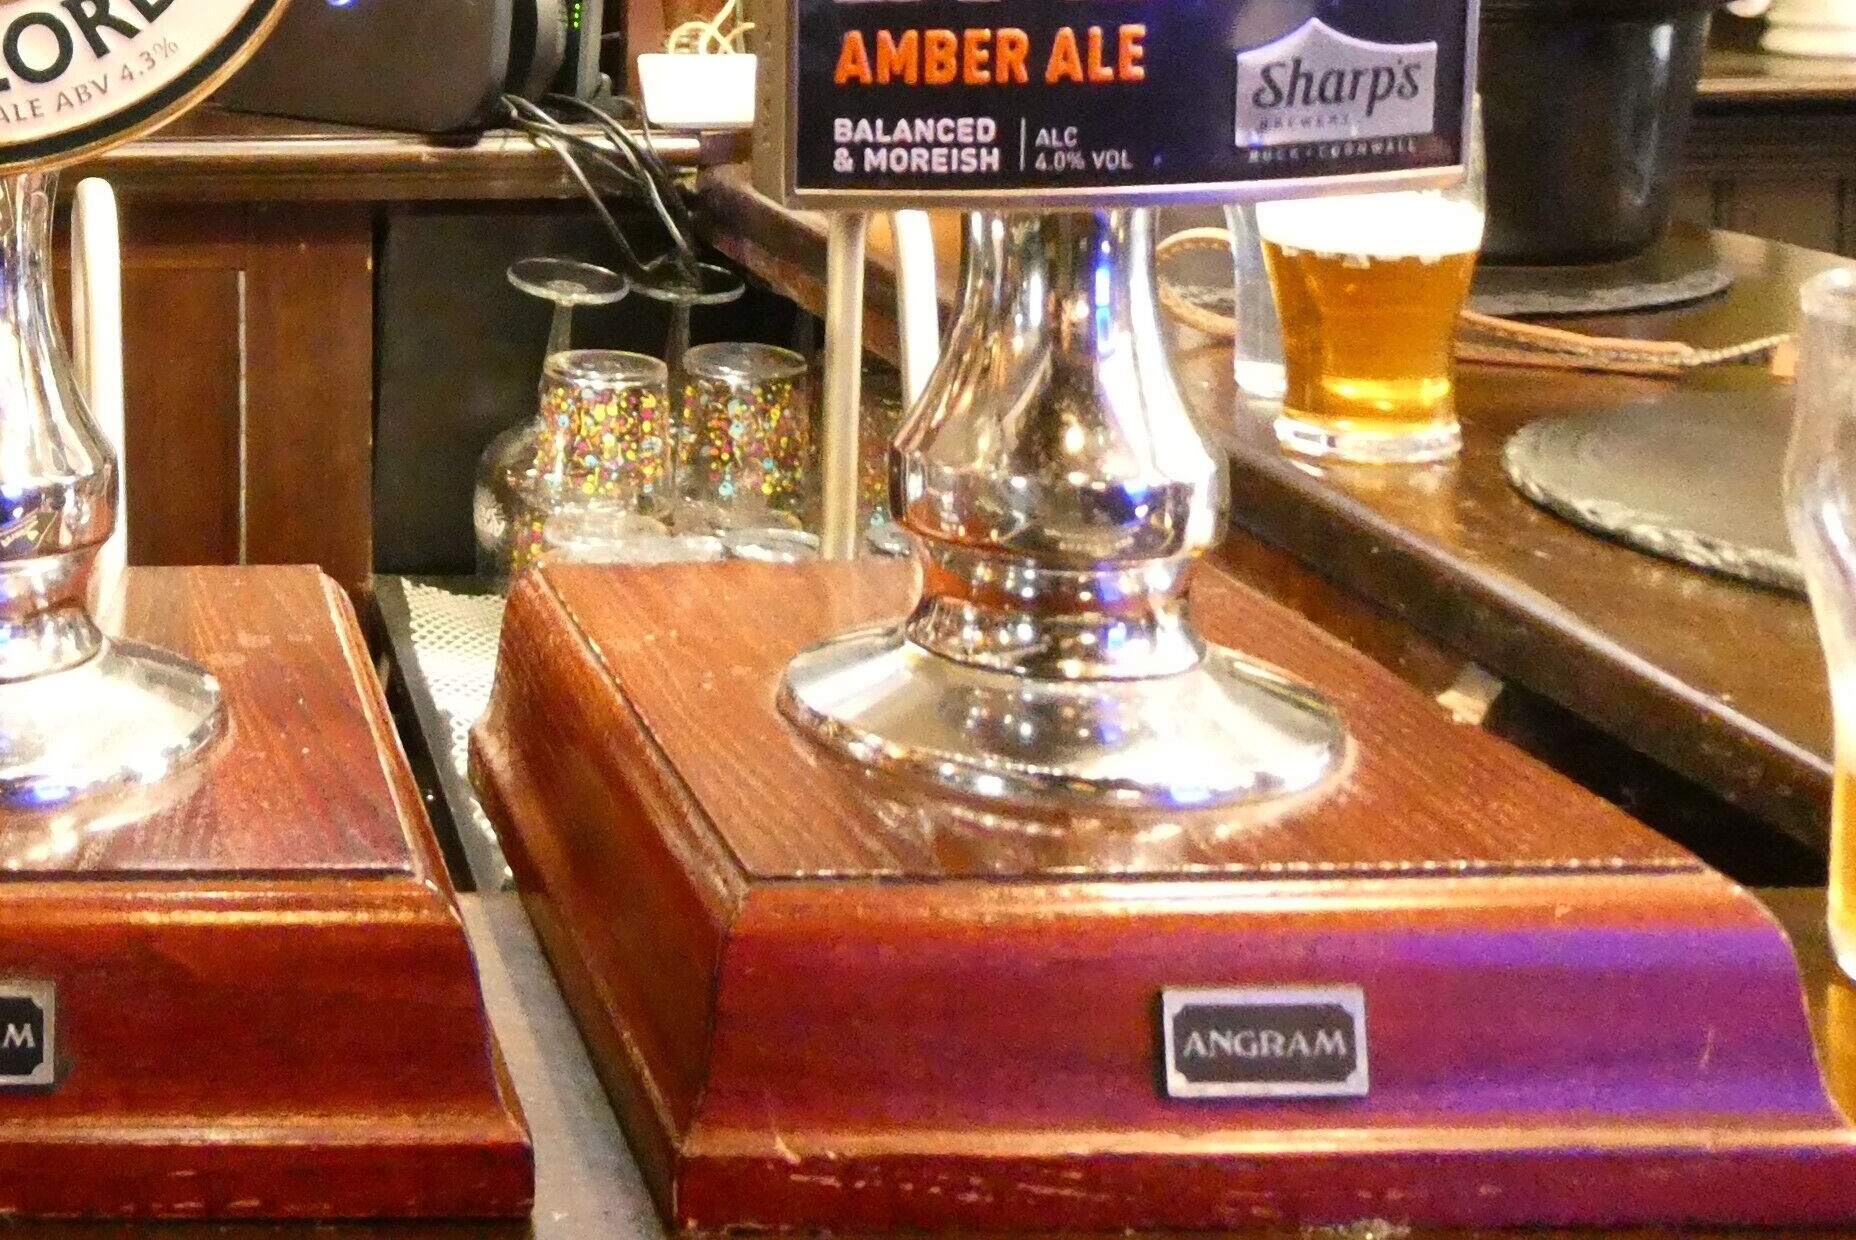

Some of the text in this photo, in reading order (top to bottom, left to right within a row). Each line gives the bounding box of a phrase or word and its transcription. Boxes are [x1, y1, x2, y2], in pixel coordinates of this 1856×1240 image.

[833, 23, 1147, 86] AMBER ALE
[54, 73, 110, 114] ABV
[118, 35, 180, 83] 4.3%
[1251, 57, 1422, 118] Sharp's
[833, 116, 997, 145] BALANCED
[1034, 125, 1080, 149] ALC
[833, 146, 1001, 174] & MOREISH
[1034, 148, 1135, 172] 4.0% VOL
[1182, 1028, 1347, 1059] ANGRAM
